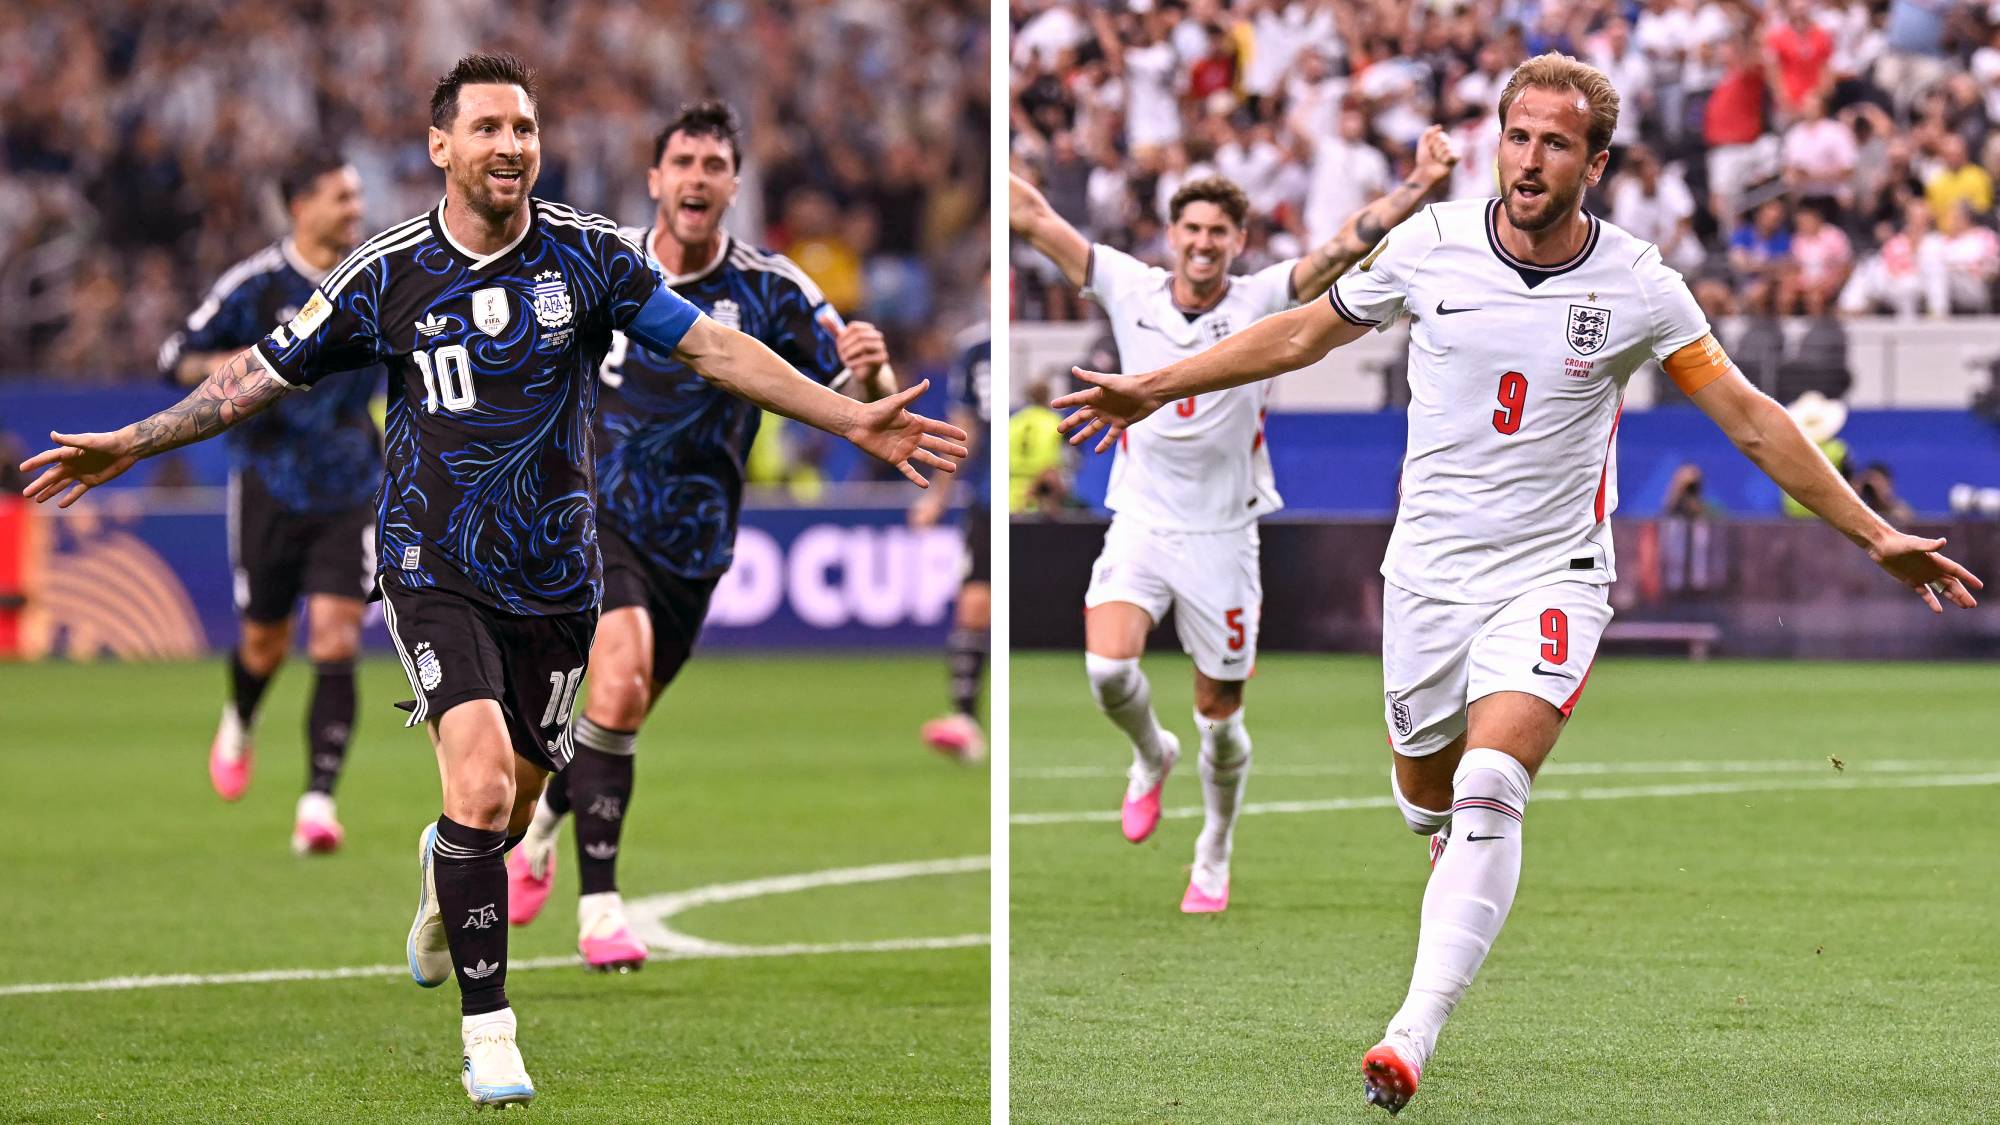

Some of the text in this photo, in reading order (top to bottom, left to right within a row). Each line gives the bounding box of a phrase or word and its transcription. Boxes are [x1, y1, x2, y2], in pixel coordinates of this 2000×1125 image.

[412, 345, 477, 414] 10
[1564, 358, 1594, 369] CROATIA
[1492, 371, 1528, 435] 9
[788, 523, 966, 628] CUP
[1225, 608, 1245, 650] 5
[1540, 608, 1568, 665] 9
[540, 664, 585, 728] 10
[462, 903, 499, 929] AFA
